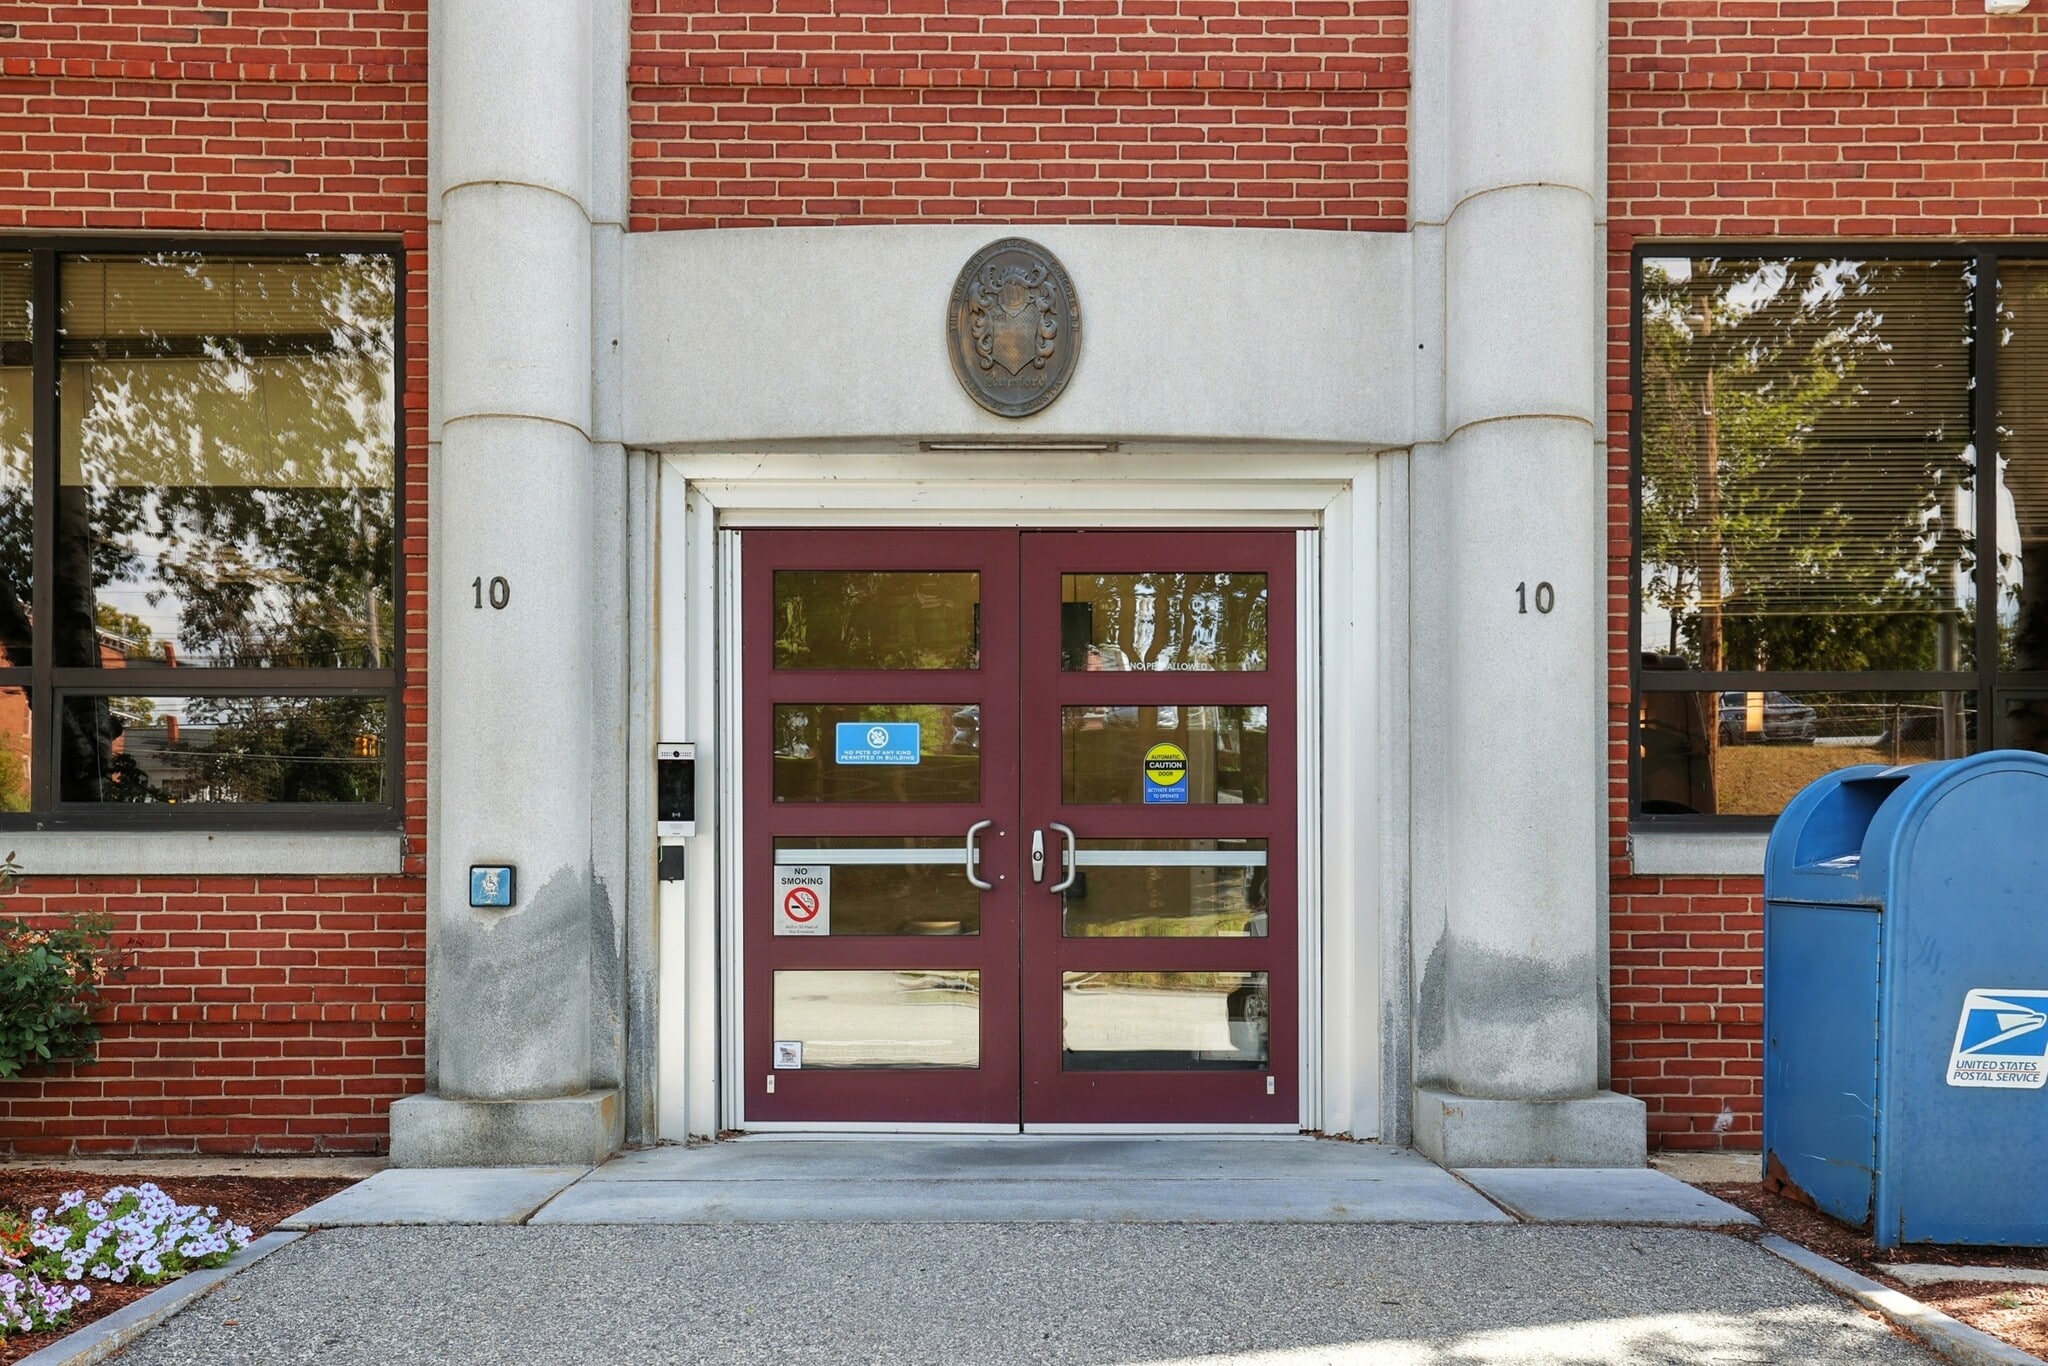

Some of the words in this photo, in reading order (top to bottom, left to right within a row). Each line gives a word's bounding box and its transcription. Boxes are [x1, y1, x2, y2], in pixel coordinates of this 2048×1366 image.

[472, 576, 510, 610] 10
[1515, 581, 1555, 614] 10
[1130, 662, 1144, 670] NO
[1167, 662, 1208, 671] ALLOWED
[1149, 761, 1183, 769] CAUTION
[794, 867, 808, 875] NO
[781, 877, 824, 885] SMOKING
[1955, 1060, 1998, 1070] UNITED
[1999, 1061, 2038, 1071] STATES
[1953, 1071, 1993, 1081] POSTAL
[1995, 1072, 2041, 1083] SERVICE
